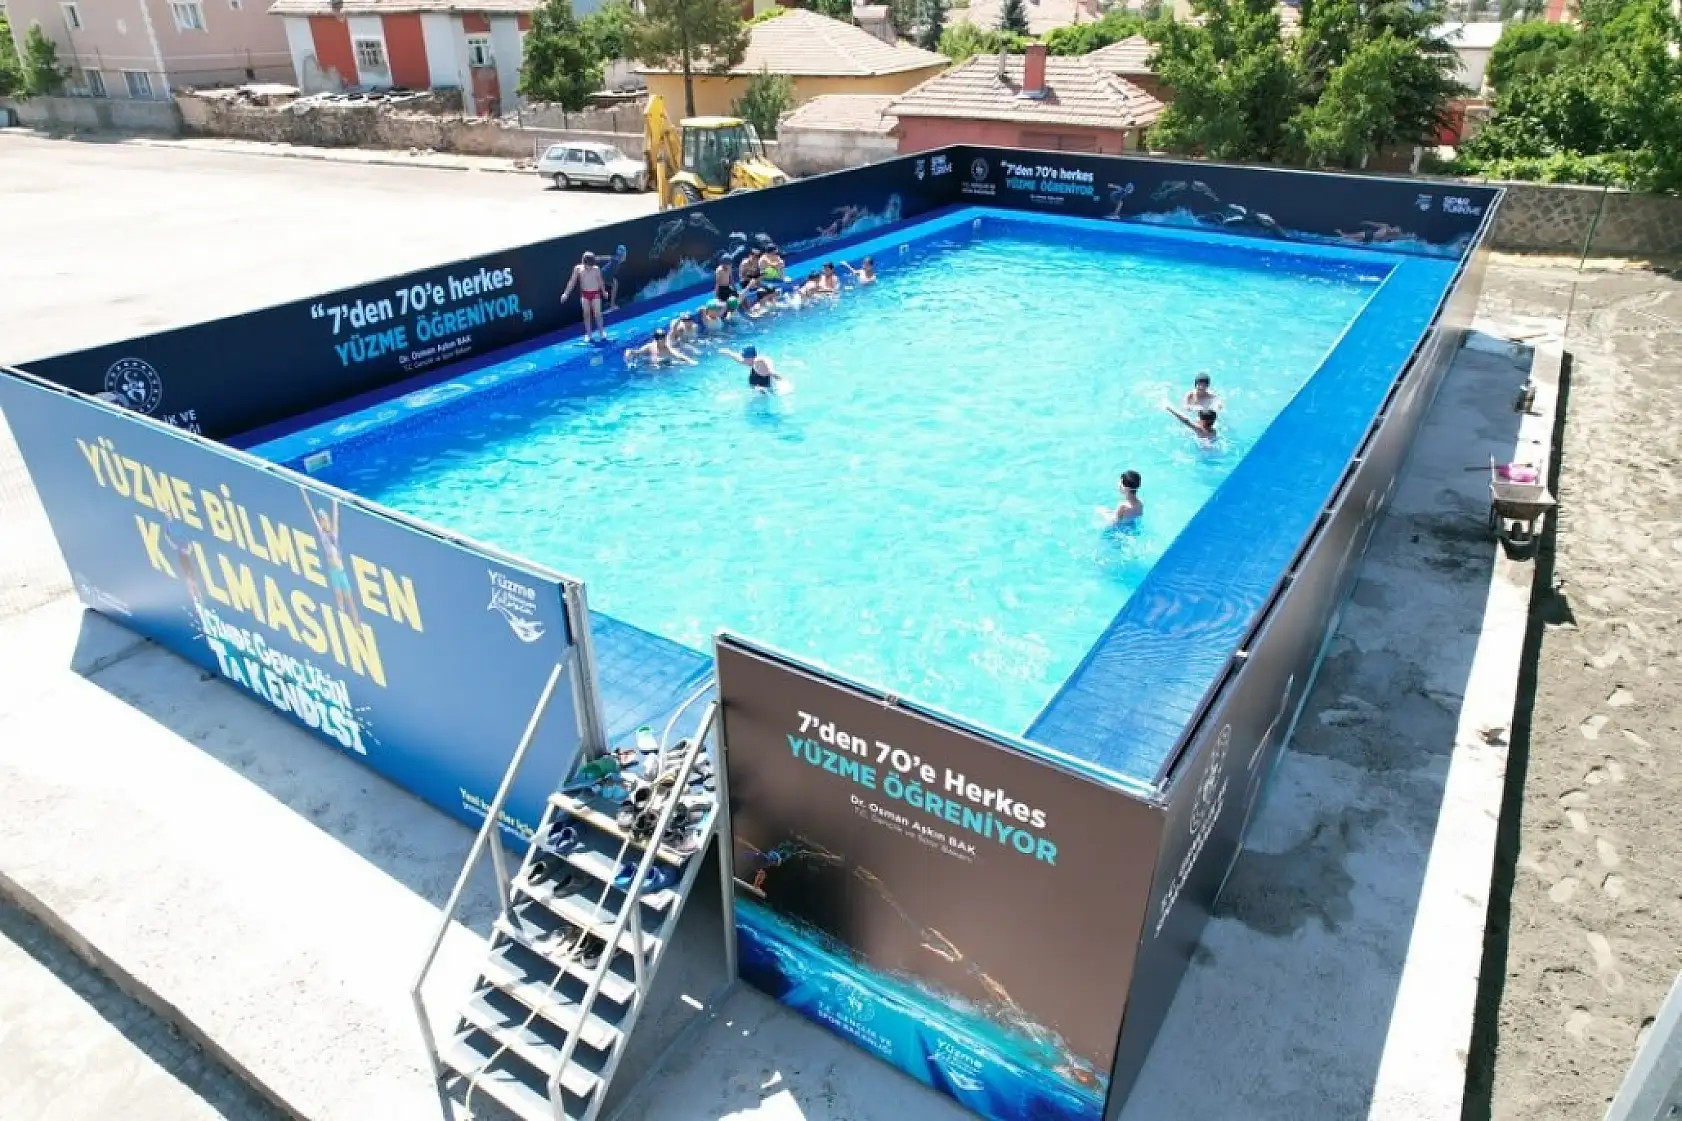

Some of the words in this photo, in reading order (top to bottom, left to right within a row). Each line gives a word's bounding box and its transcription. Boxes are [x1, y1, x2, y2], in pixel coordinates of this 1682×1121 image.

[1059, 167, 1094, 183] herkes
[448, 267, 514, 300] herkes
[334, 326, 408, 367] YÜZME
[76, 435, 203, 531] YÜZME
[199, 483, 423, 633] BİLMEEN
[133, 513, 388, 689] KLMASIN
[786, 732, 877, 790] YÜZME
[883, 771, 1059, 866] ÖĞRENİYOR
[850, 793, 867, 808] Dr.
[868, 802, 909, 826] Osman
[948, 836, 976, 856] BAK
[944, 767, 1048, 829] Herkes
